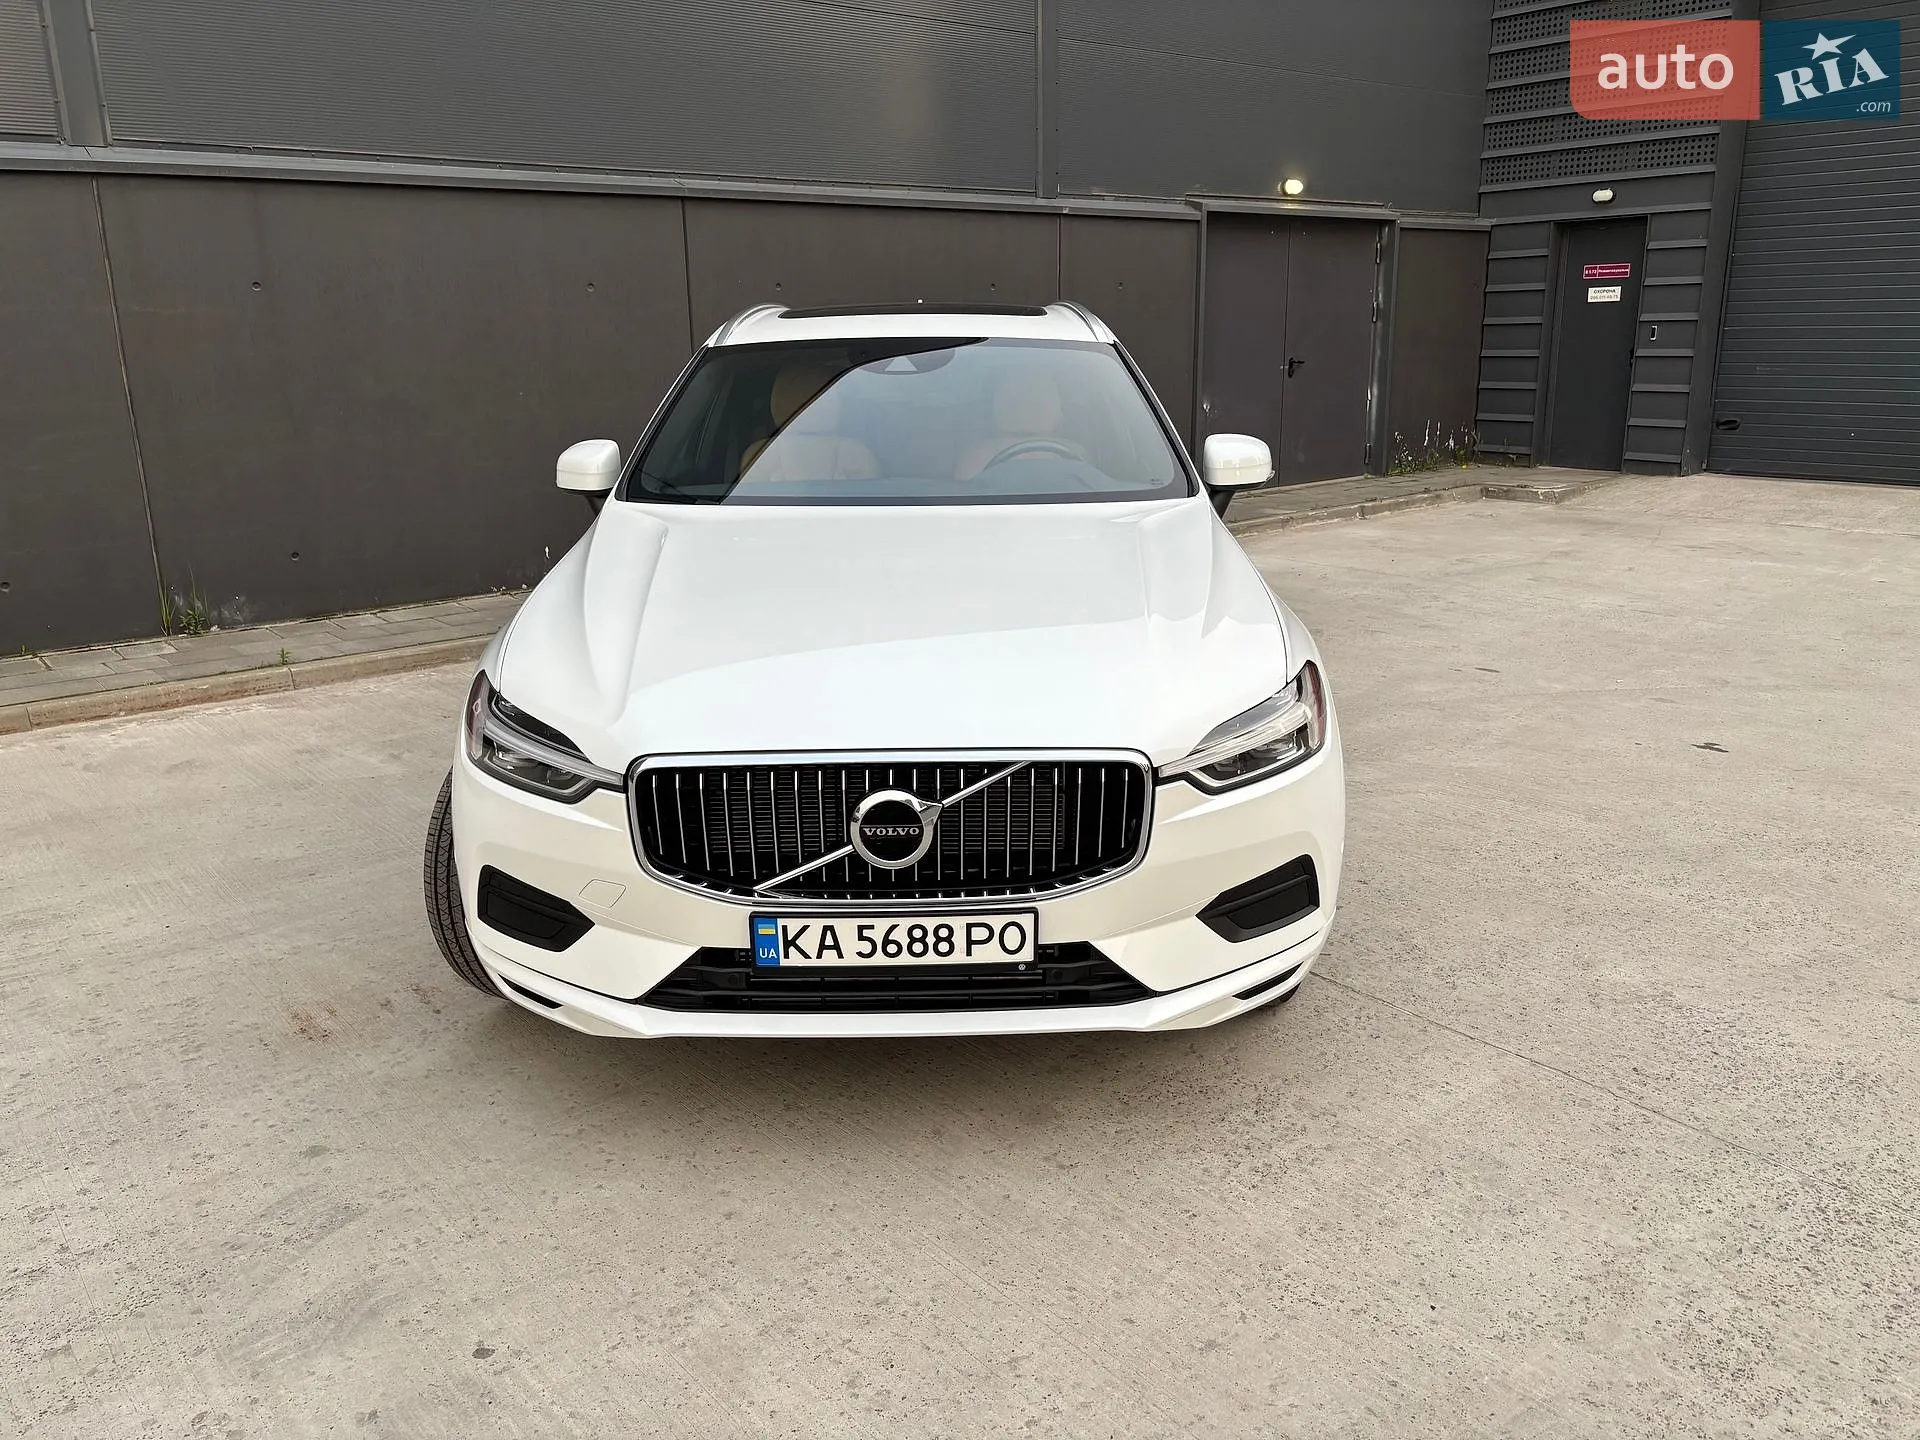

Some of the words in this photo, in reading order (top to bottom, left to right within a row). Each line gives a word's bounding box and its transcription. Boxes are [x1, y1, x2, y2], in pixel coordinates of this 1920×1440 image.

[862, 826, 920, 836] VOLVO
[780, 924, 845, 960] KA
[855, 923, 956, 959] 5688
[965, 921, 1027, 957] PO
[759, 949, 778, 959] UA
